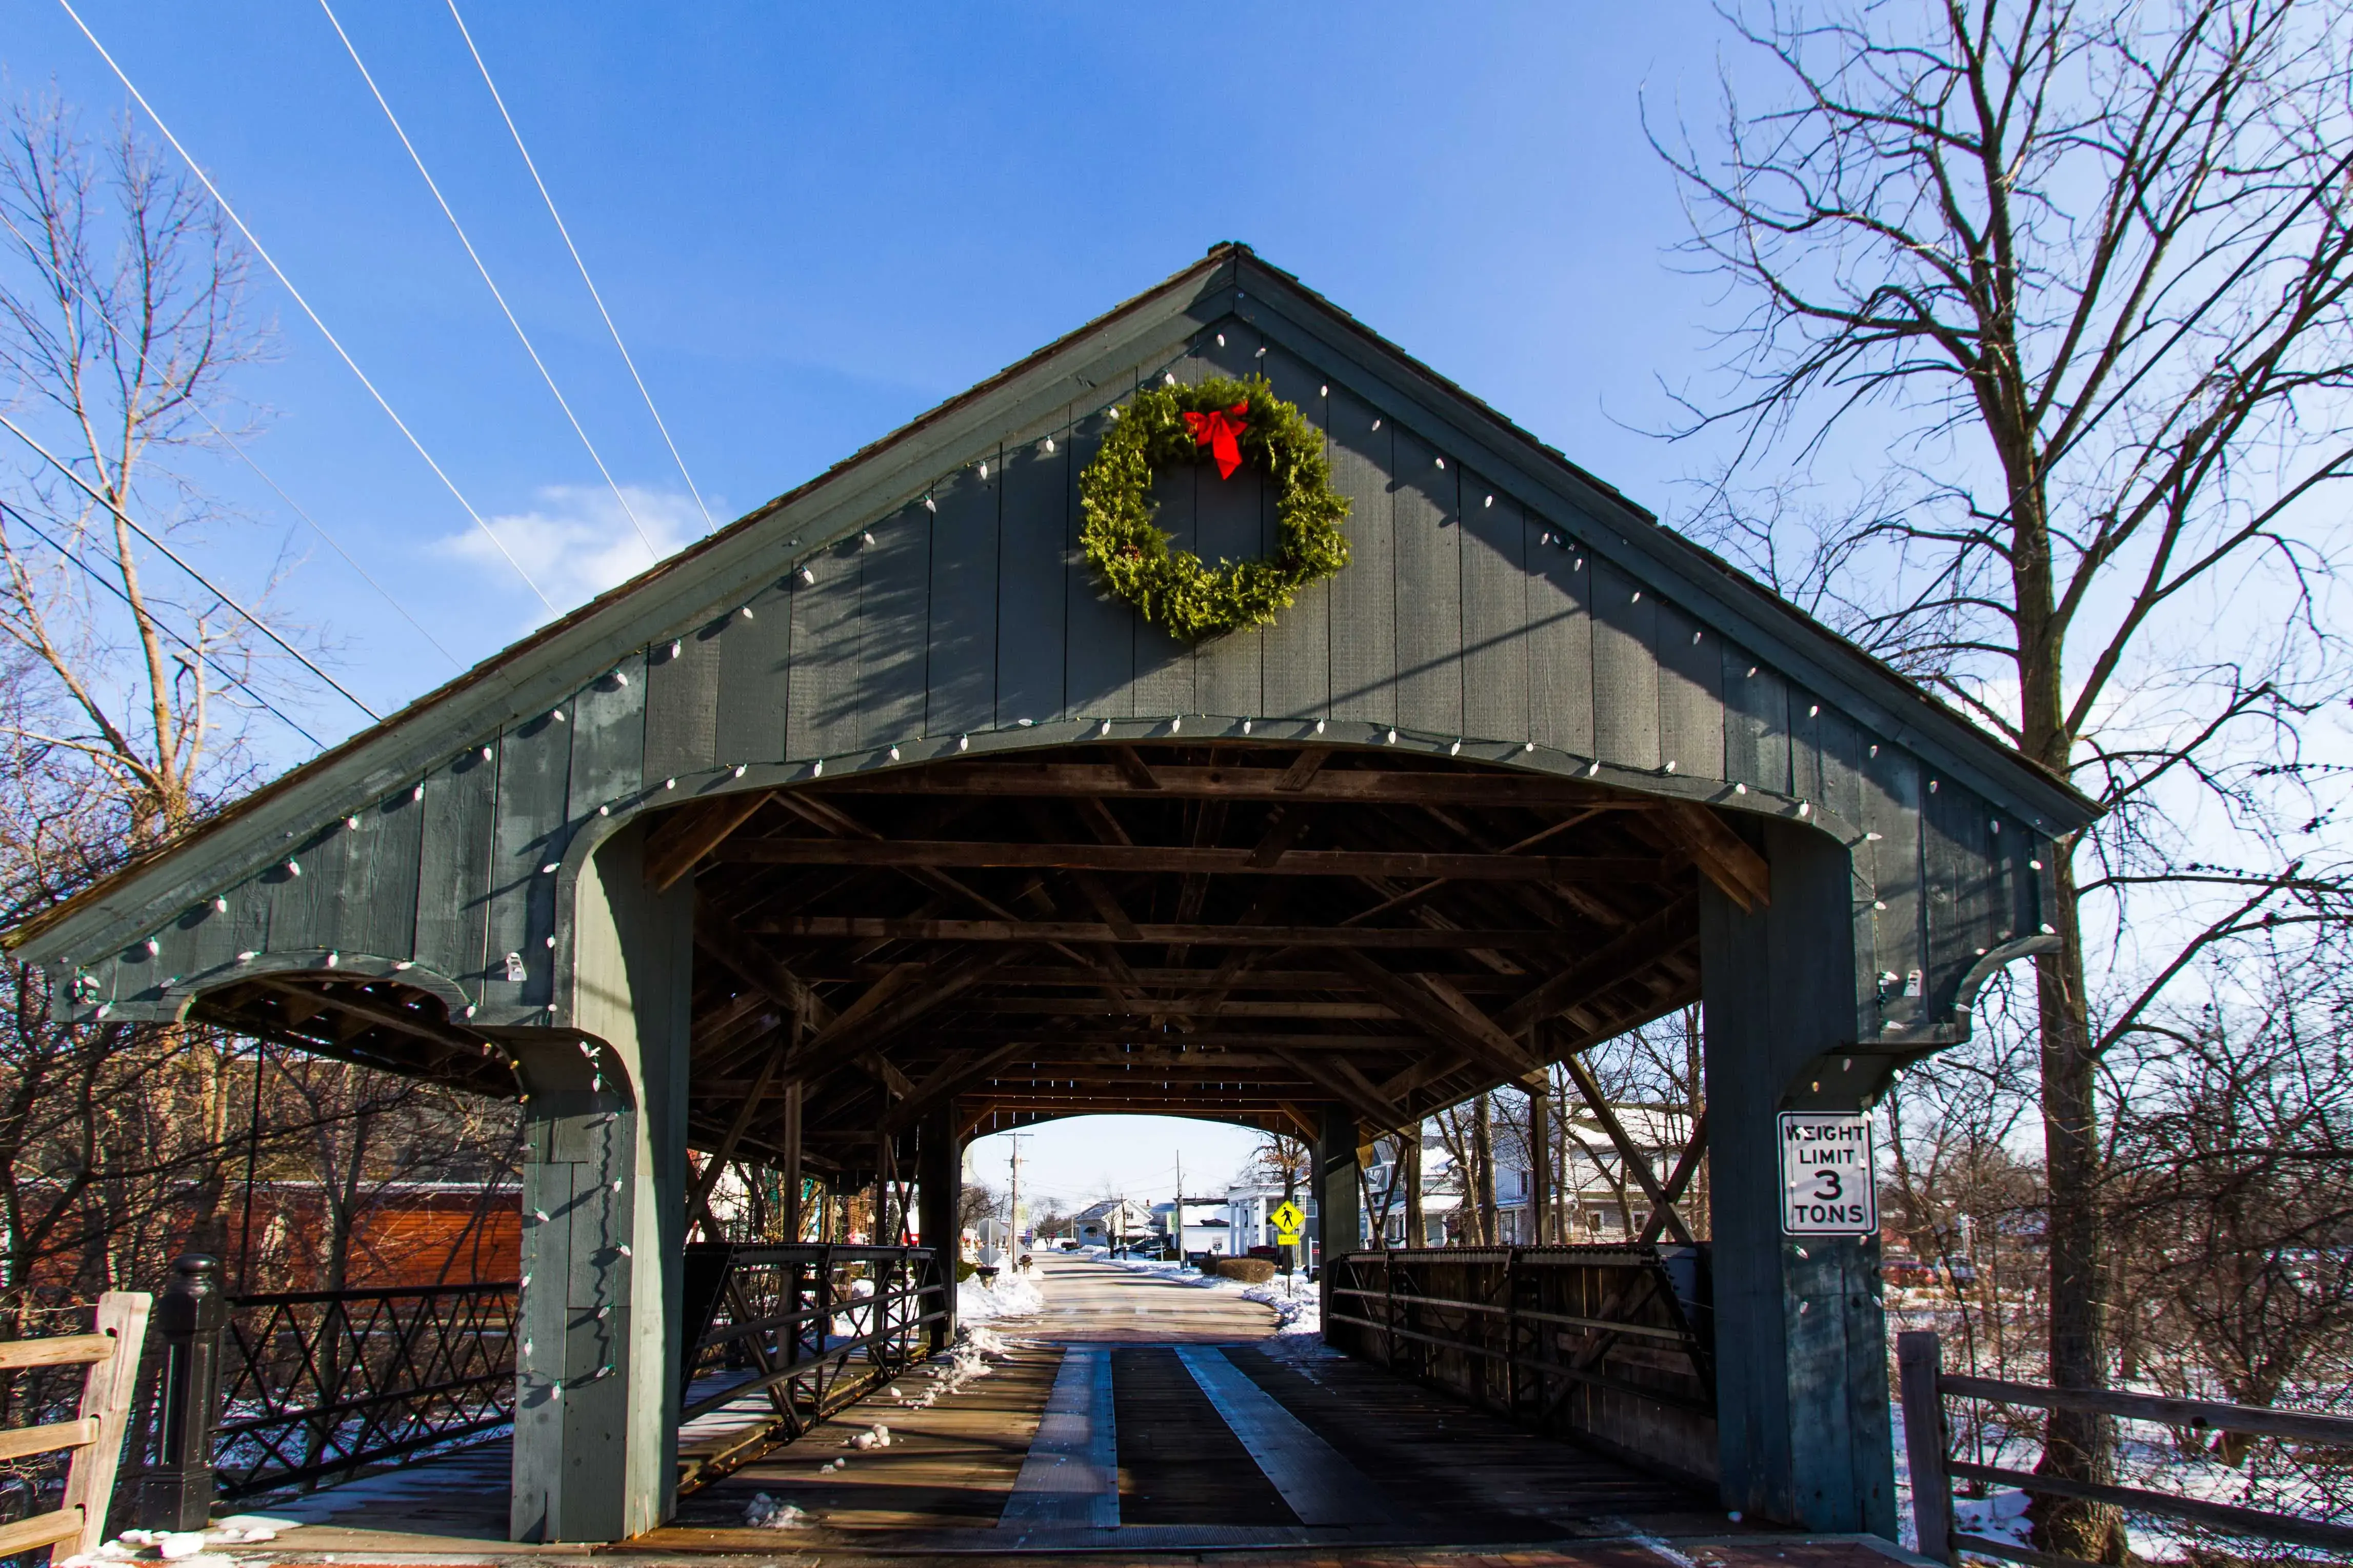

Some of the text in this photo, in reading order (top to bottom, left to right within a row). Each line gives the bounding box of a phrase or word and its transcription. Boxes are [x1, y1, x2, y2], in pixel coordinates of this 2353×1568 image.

[1786, 1126, 1864, 1141] WEIGHT
[1800, 1149, 1855, 1164] LIMIT
[1813, 1170, 1842, 1200] 3
[1794, 1205, 1864, 1223] TONS
